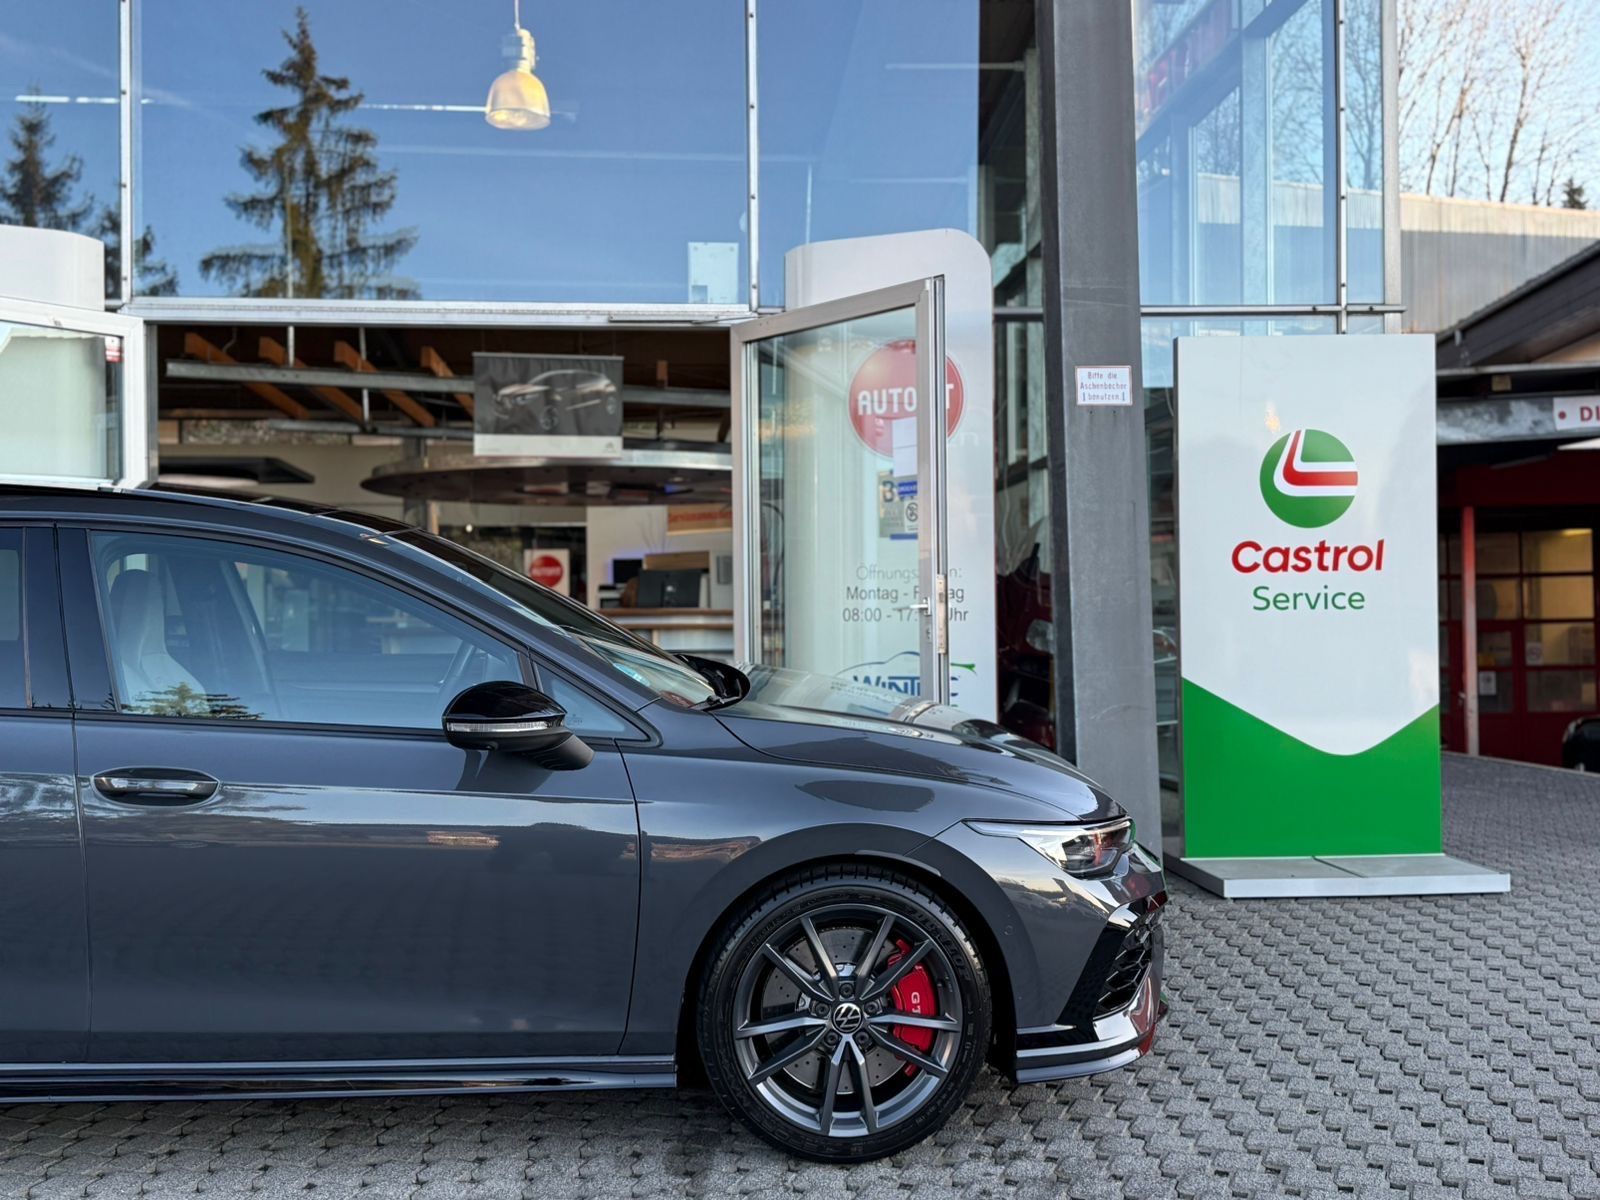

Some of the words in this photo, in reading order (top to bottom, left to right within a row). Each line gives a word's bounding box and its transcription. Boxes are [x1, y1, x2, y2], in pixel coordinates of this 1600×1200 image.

[1087, 371, 1104, 380] Bitte
[1107, 371, 1118, 380] die
[857, 383, 955, 416] AUTOT
[1087, 392, 1120, 401] benutzen
[1231, 538, 1385, 574] Castrol
[846, 585, 899, 603] Montag
[1252, 584, 1366, 611] Service
[842, 607, 882, 622] 08:00
